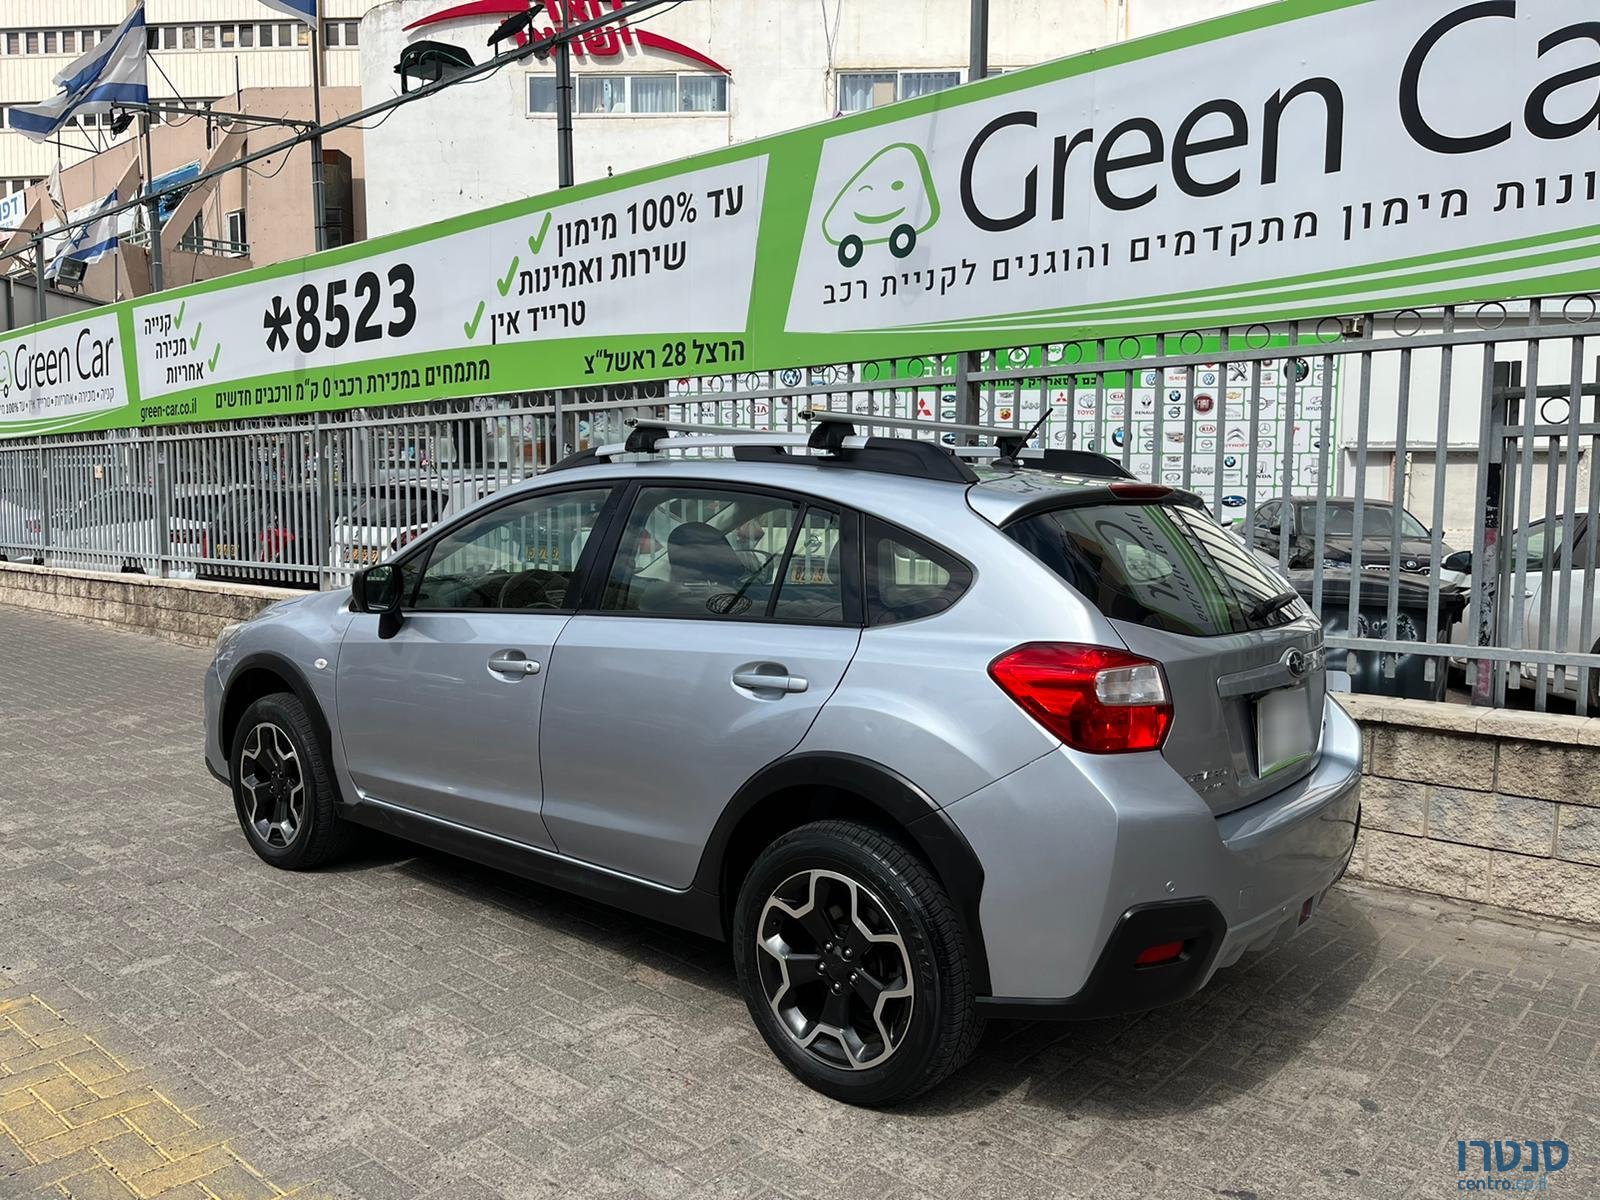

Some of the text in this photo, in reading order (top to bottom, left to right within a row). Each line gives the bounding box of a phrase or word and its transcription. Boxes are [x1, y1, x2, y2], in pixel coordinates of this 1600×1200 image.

[961, 0, 1600, 233] Green Ca
[557, 184, 743, 258] עד 100% מימון
[1343, 189, 1468, 241] מימון
[1128, 208, 1318, 263] מתקדמים
[518, 240, 686, 296] שירות ואמינות
[992, 243, 1109, 282] והוגנים
[880, 257, 977, 297] לקניית
[823, 279, 868, 305] רכב
[144, 313, 172, 337] קנייה
[490, 300, 586, 346] טרייד אין
[14, 328, 114, 391] Green Car
[155, 337, 187, 359] מכירה
[661, 341, 687, 368] 28
[692, 338, 745, 365] הרצל
[166, 362, 204, 385] אחריות
[366, 370, 421, 394] במכירת
[425, 359, 490, 387] מתמחים
[215, 389, 252, 409] חדשים
[255, 384, 292, 405] ורכבים
[322, 376, 331, 399] 0
[333, 376, 363, 398] רכבי
[140, 398, 198, 423] green-car.co.il
